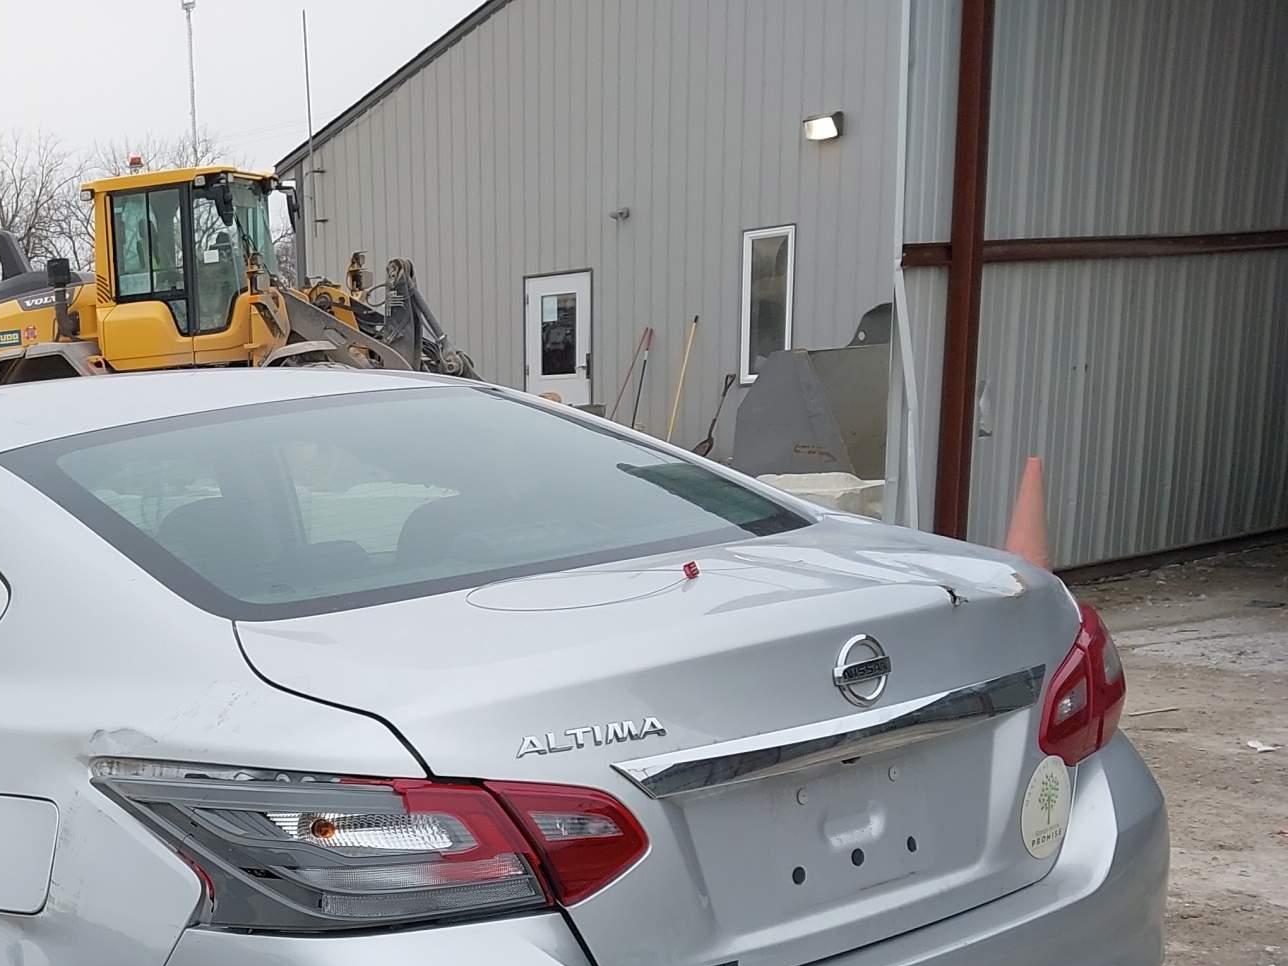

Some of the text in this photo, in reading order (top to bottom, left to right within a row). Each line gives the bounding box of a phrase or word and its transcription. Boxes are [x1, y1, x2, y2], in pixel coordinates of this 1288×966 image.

[842, 661, 889, 681] NISSAN
[516, 716, 668, 759] ALTIMA
[1031, 827, 1063, 848] PROMISE
